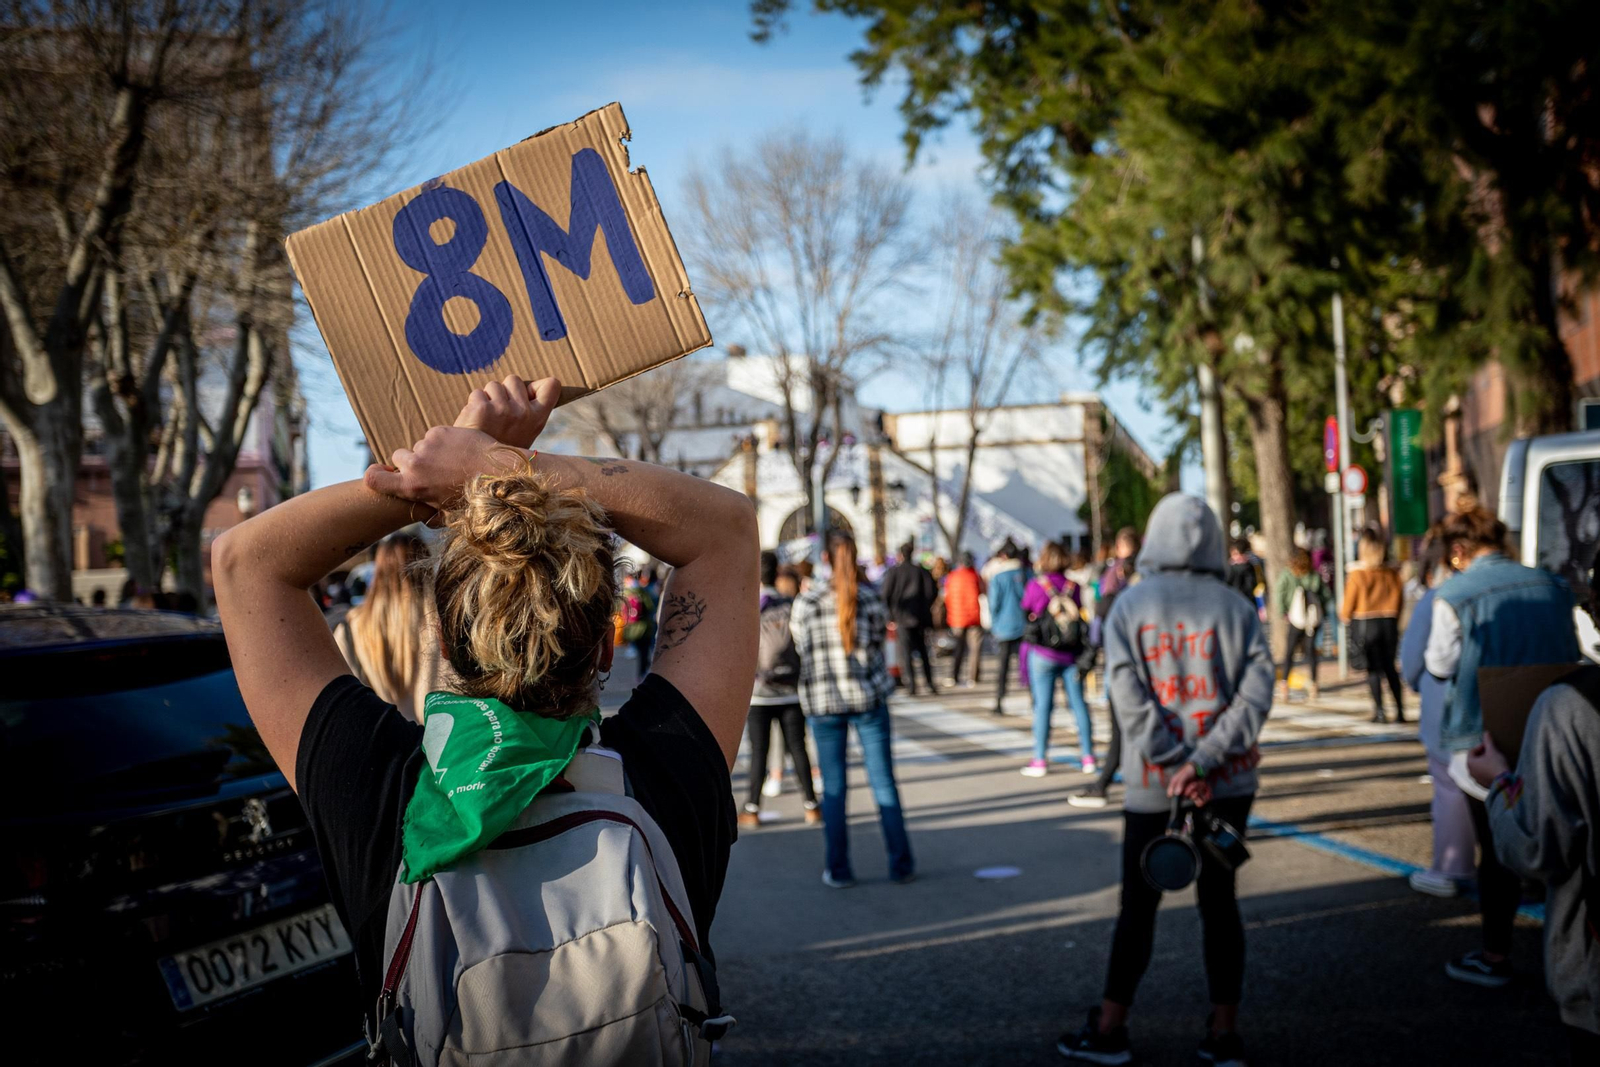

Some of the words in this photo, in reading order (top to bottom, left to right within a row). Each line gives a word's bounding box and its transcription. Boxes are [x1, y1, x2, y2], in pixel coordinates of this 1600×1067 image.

[393, 148, 656, 375] 8M
[483, 710, 501, 730] para
[493, 731, 503, 744] no
[456, 781, 486, 793] morir
[187, 934, 278, 994] 0072
[277, 912, 338, 964] KYY
